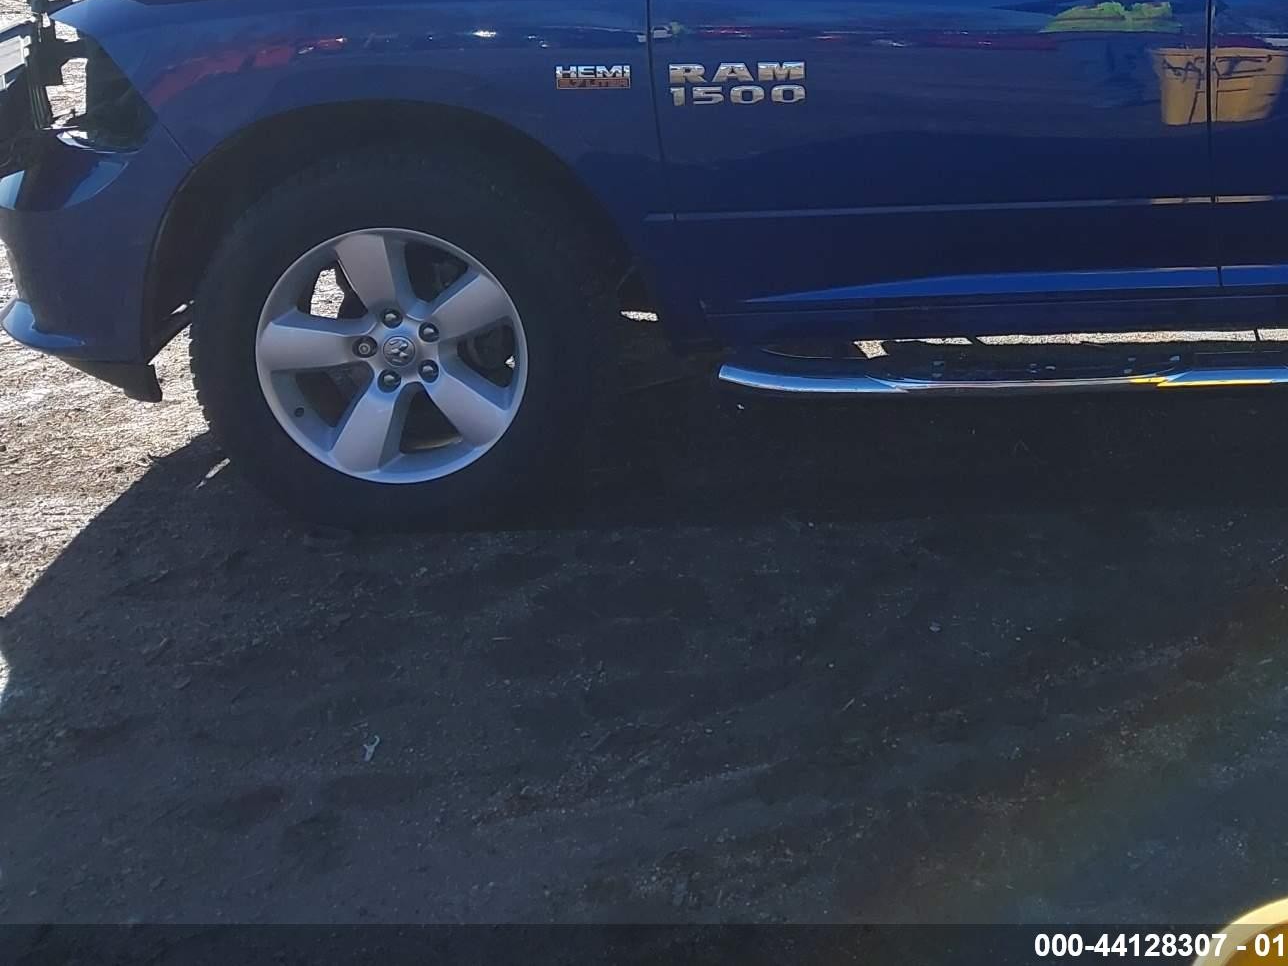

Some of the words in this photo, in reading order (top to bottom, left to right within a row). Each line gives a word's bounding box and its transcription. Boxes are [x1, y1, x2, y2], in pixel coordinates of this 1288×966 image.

[556, 65, 631, 79] HEMI
[668, 61, 806, 84] RAM
[670, 85, 806, 107] 1500
